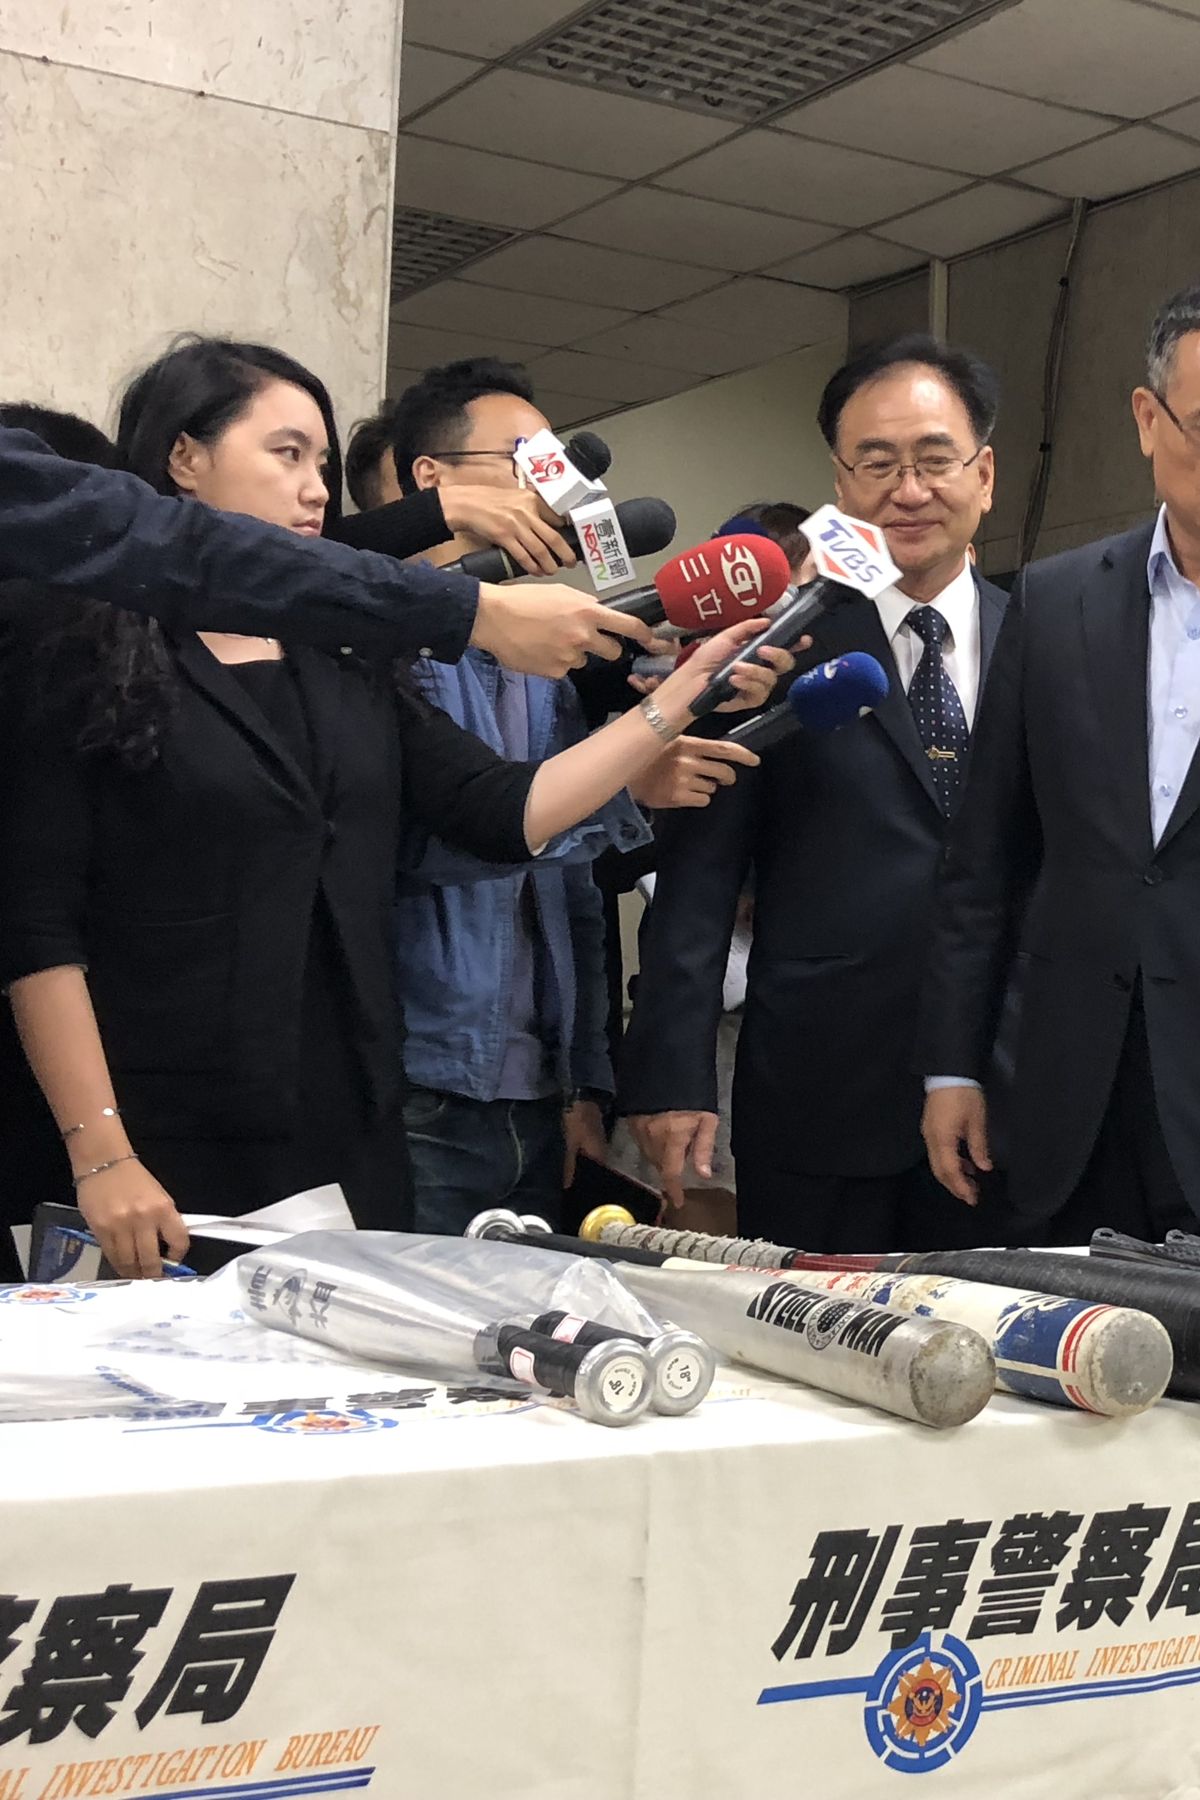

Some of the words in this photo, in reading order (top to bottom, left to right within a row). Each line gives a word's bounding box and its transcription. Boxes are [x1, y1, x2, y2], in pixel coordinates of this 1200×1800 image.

[594, 518, 629, 579] 壹新聞
[819, 518, 884, 584] TVBS
[679, 553, 723, 621] 三立
[837, 1308, 910, 1357] MAN
[984, 1650, 1080, 1690] CRIMINAL
[40, 1739, 268, 1800] INVESTIGATION
[274, 1725, 381, 1772] BUREAU
